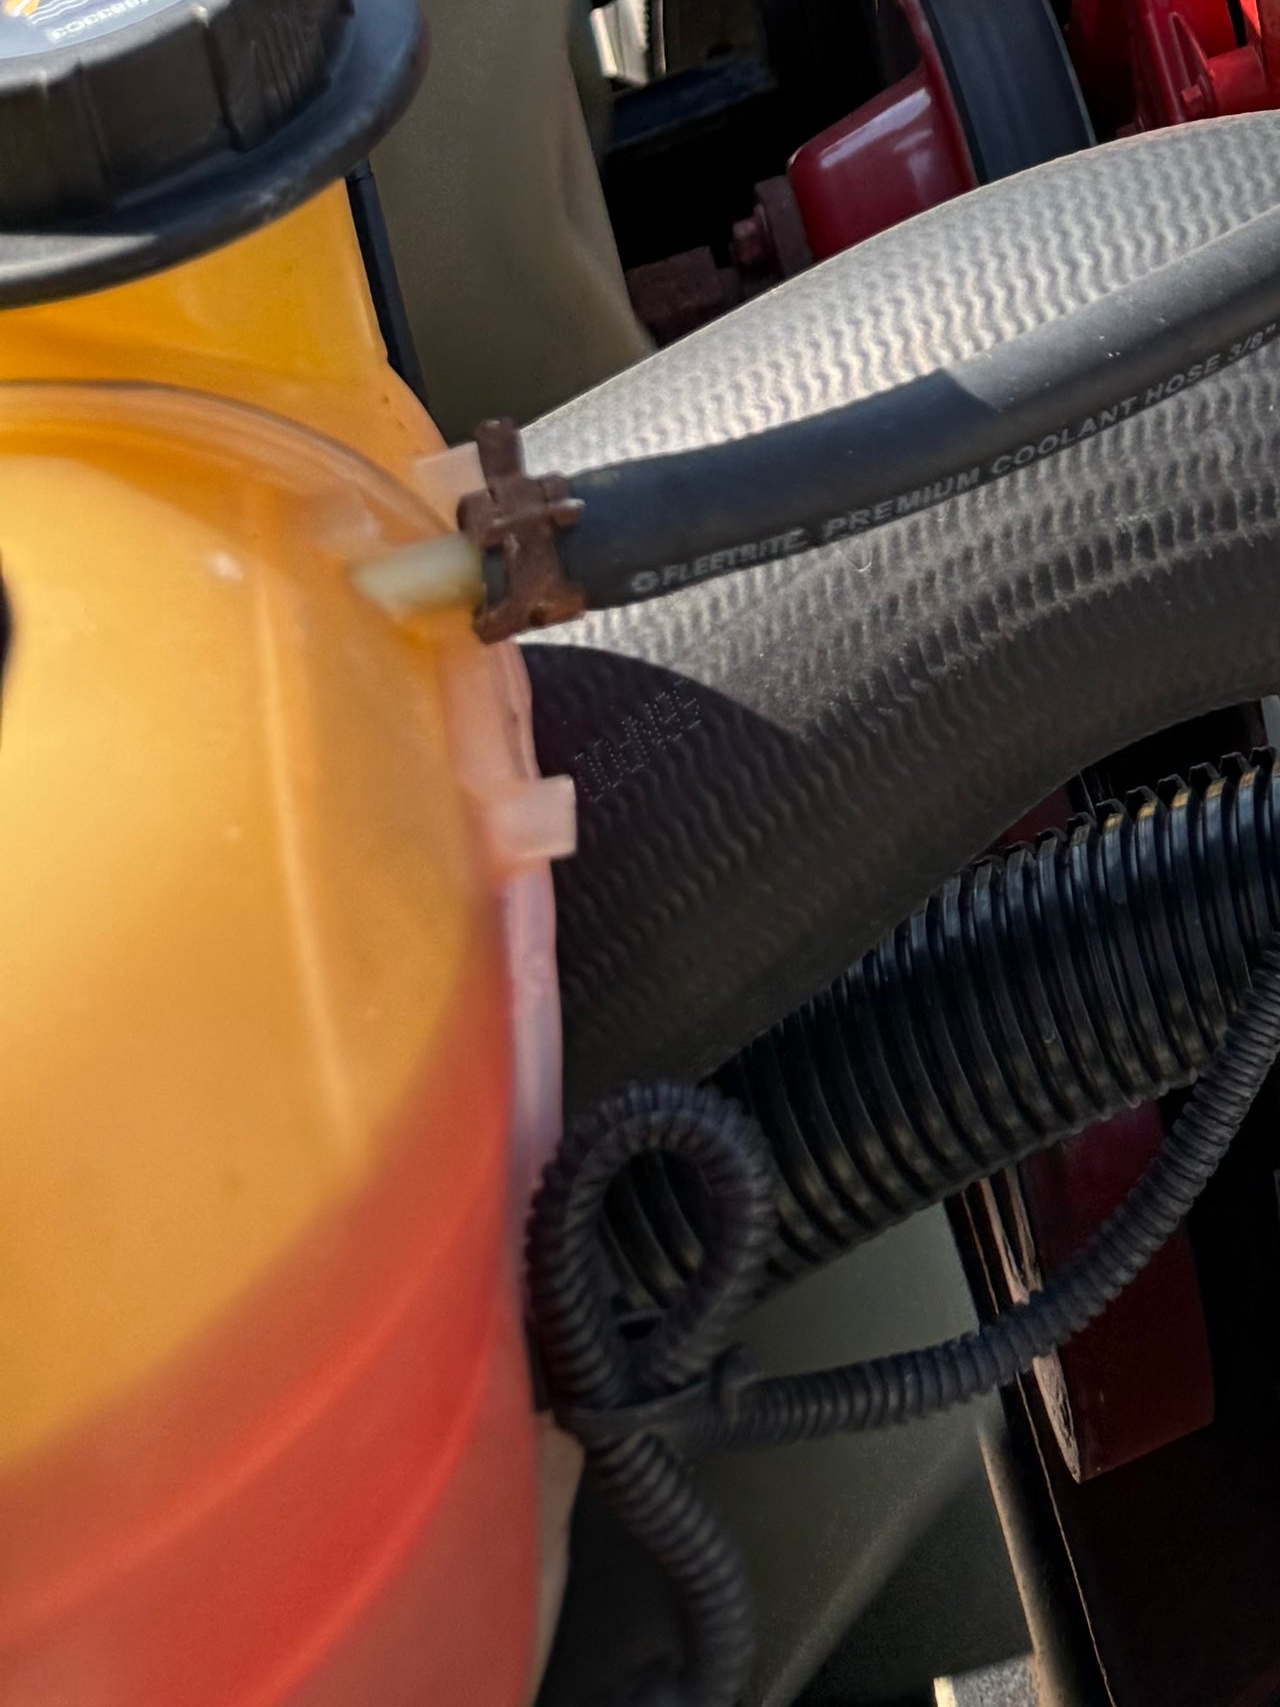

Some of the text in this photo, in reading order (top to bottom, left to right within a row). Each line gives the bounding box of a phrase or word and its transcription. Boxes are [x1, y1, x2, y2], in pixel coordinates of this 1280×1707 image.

[661, 528, 808, 586] FLEETRITE
[823, 467, 979, 537] PREMIUM
[991, 396, 1138, 475] COOLANT
[1146, 354, 1221, 405] HOSE
